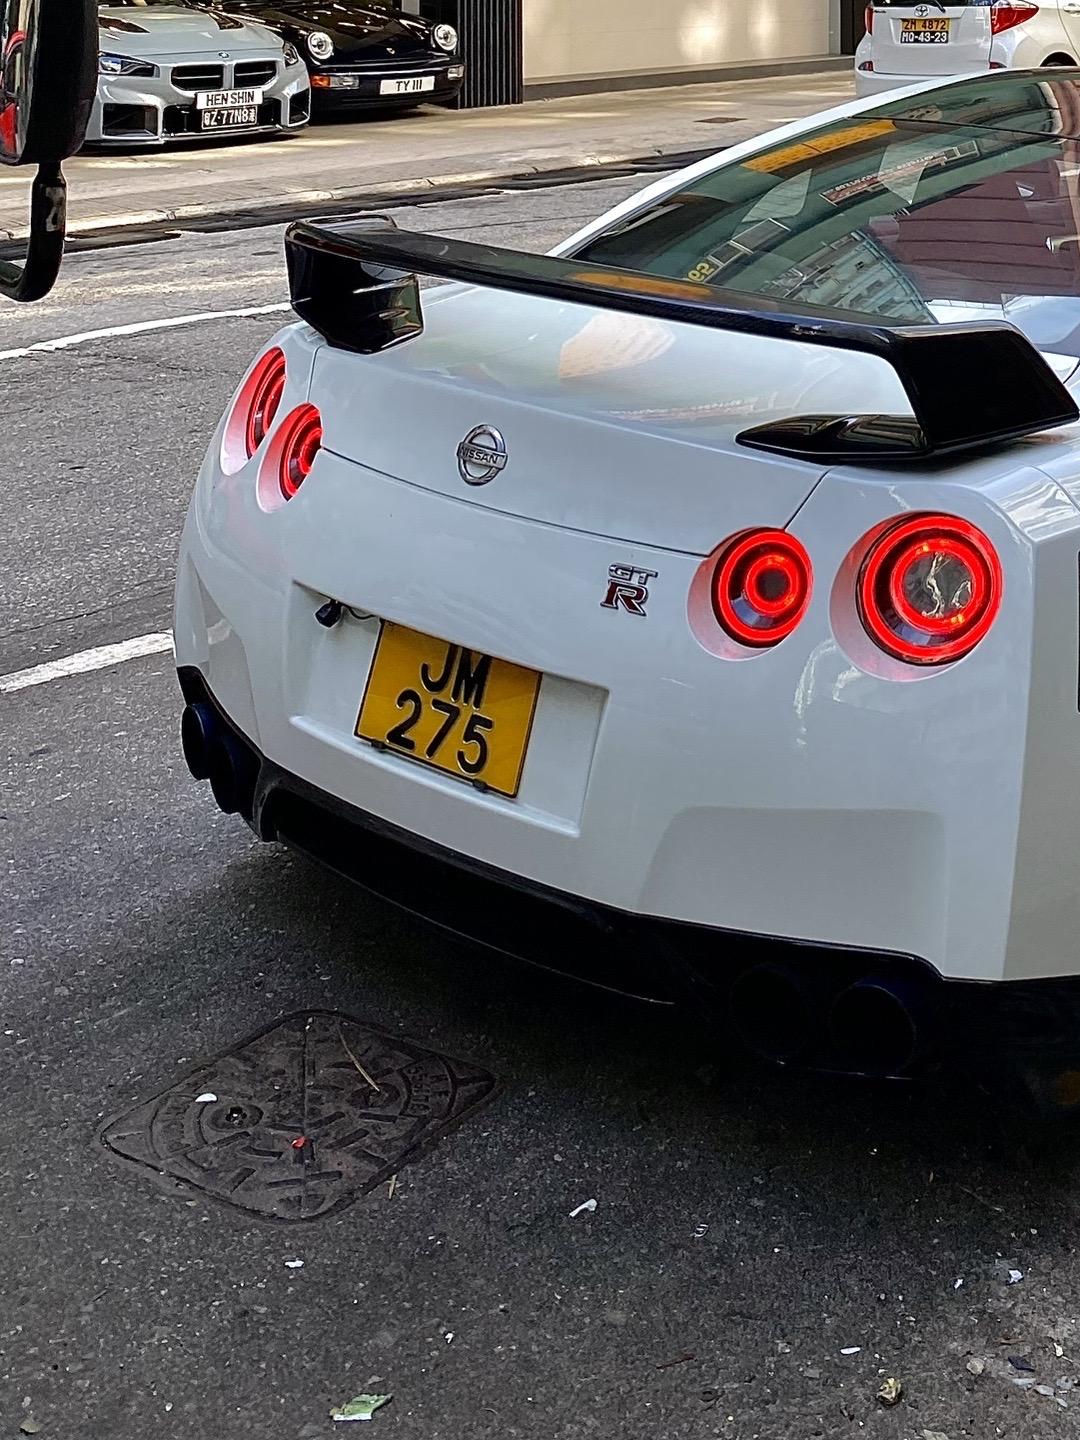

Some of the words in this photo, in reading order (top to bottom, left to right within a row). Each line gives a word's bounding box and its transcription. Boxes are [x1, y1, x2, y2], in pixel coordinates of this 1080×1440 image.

[921, 20, 946, 30] 4872
[395, 80, 409, 92] TY
[206, 93, 229, 107] HEN
[230, 91, 255, 105] SHIN
[460, 445, 500, 465] NISSAN
[608, 562, 658, 585] GT
[600, 578, 649, 617] R
[421, 646, 493, 710] JM
[385, 688, 495, 775] 275
